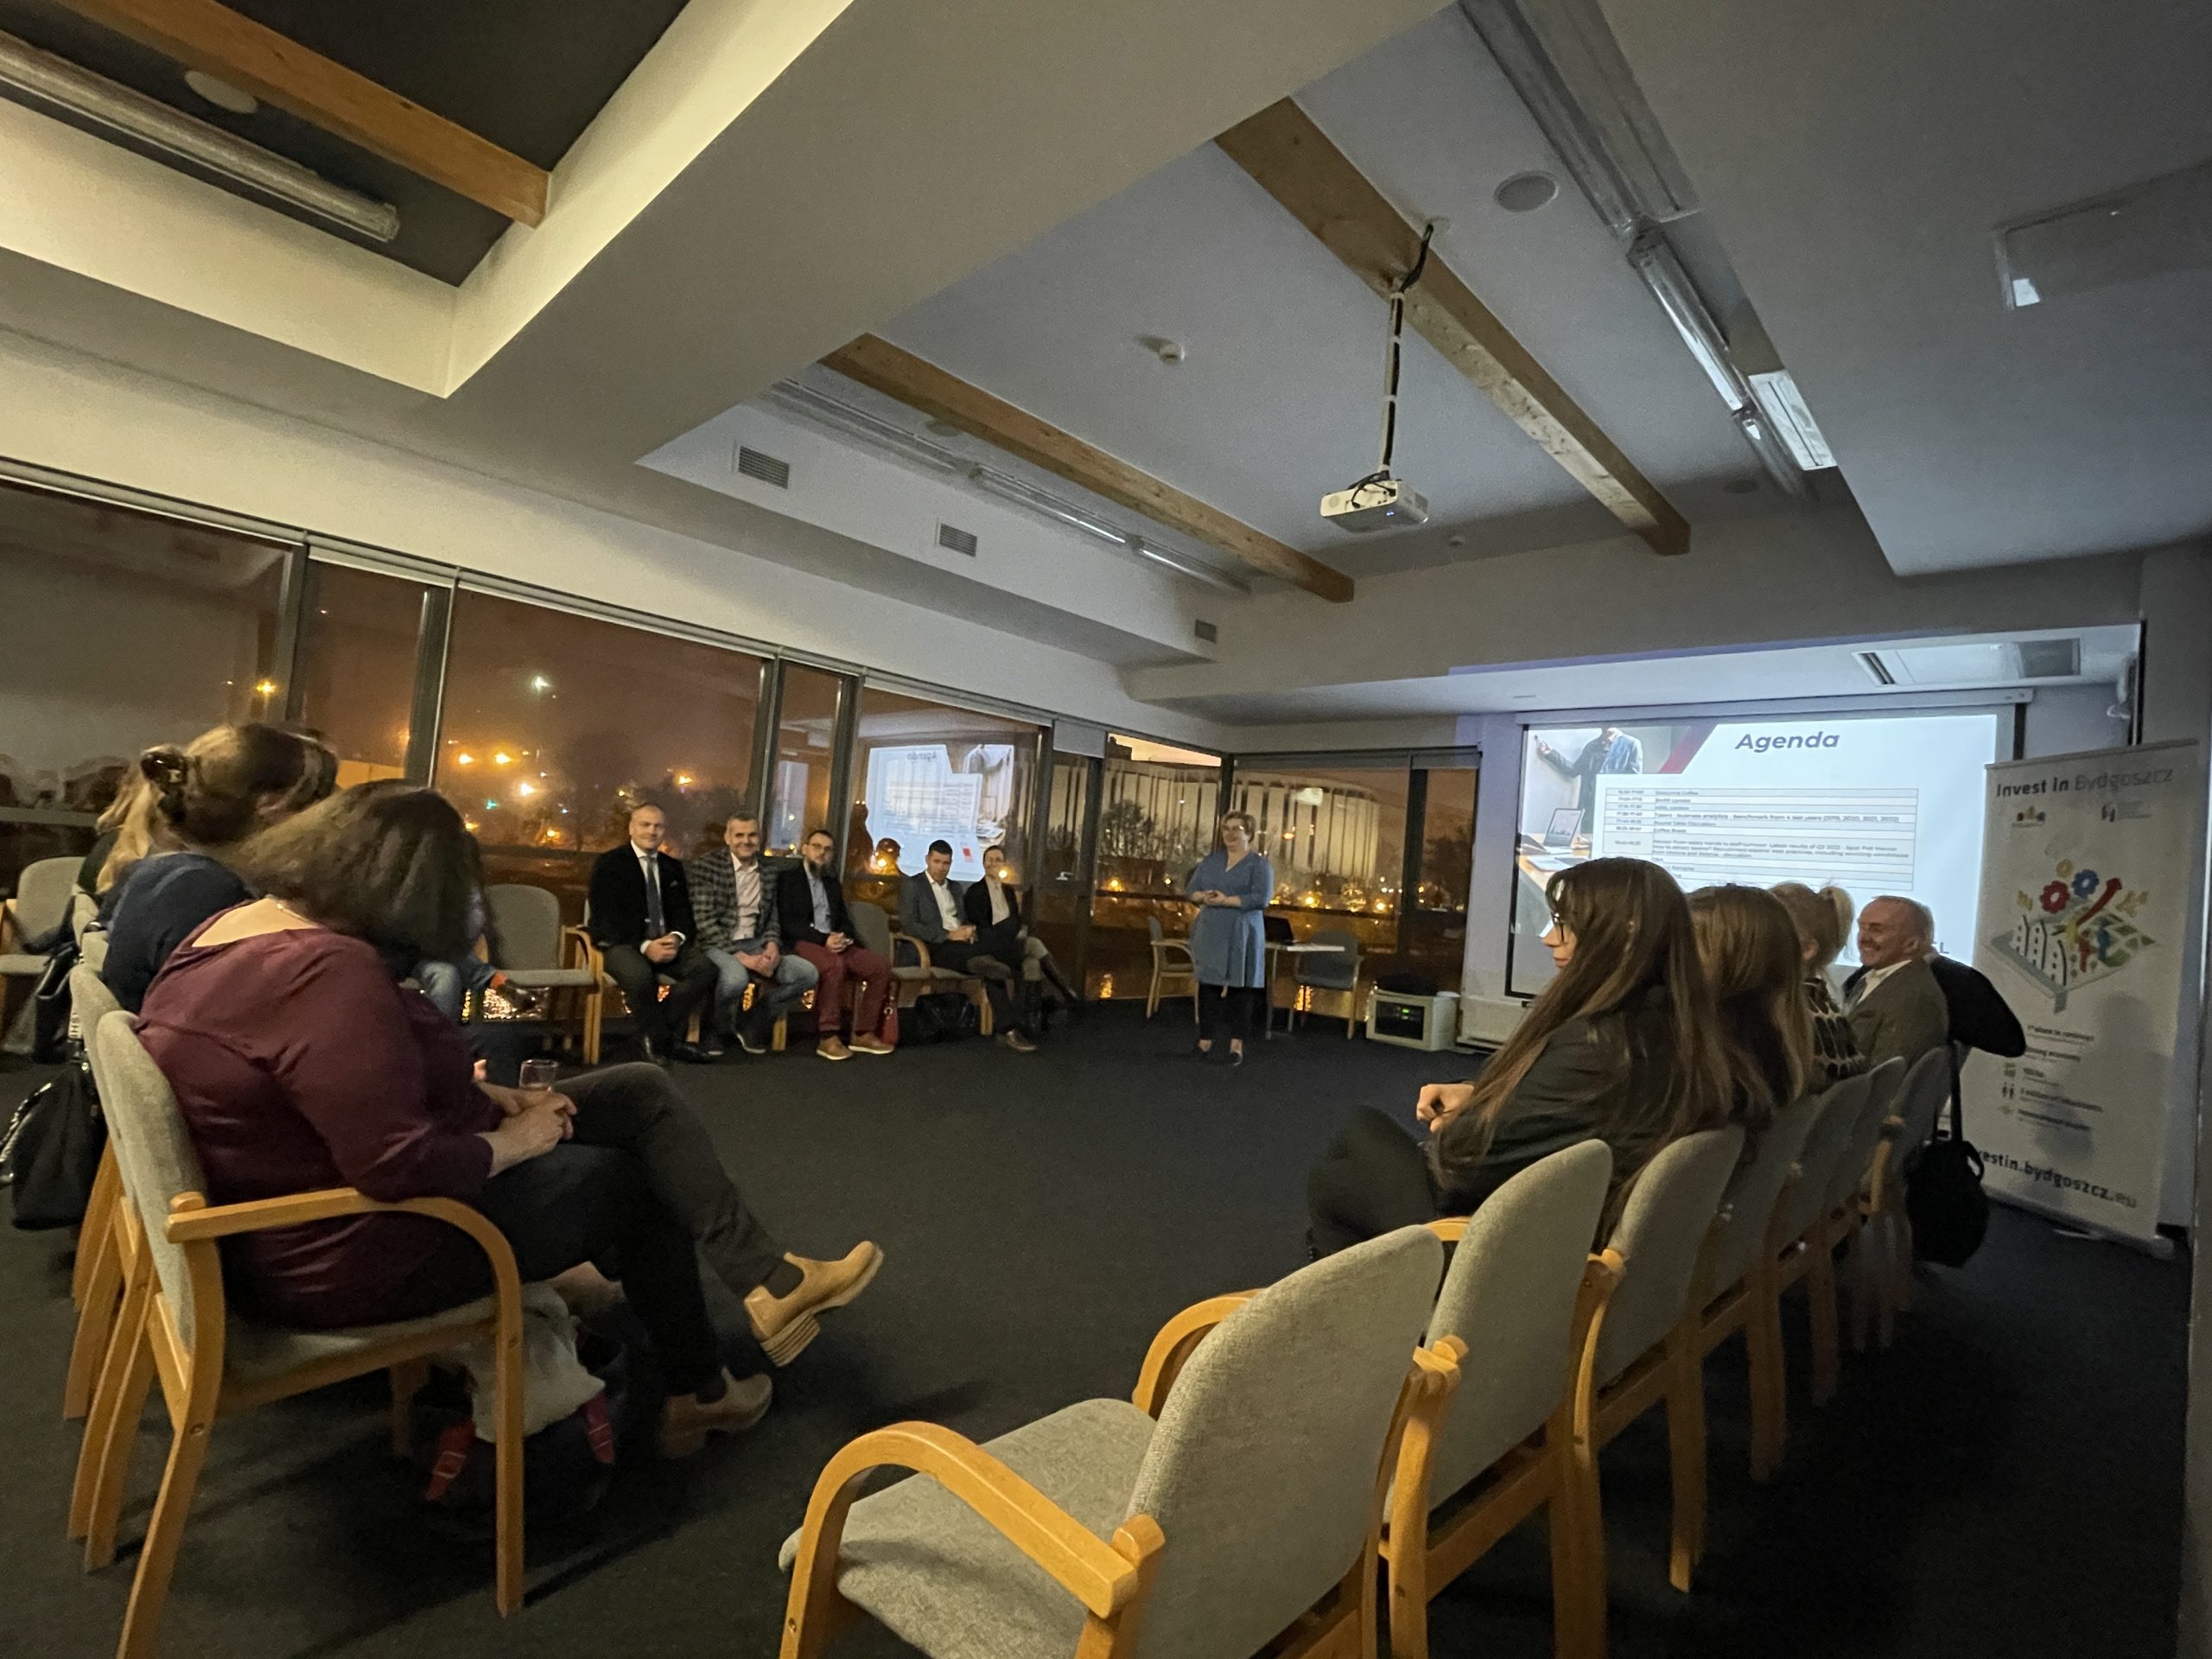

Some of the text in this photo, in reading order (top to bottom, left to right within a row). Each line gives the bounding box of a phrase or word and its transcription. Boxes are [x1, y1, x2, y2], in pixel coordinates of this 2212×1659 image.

[1734, 731, 1840, 753] Agenda
[1996, 769, 2174, 797] Invest in Bydgoszcz
[1980, 1150, 2137, 1208] estin.bydgoszcz.eu
